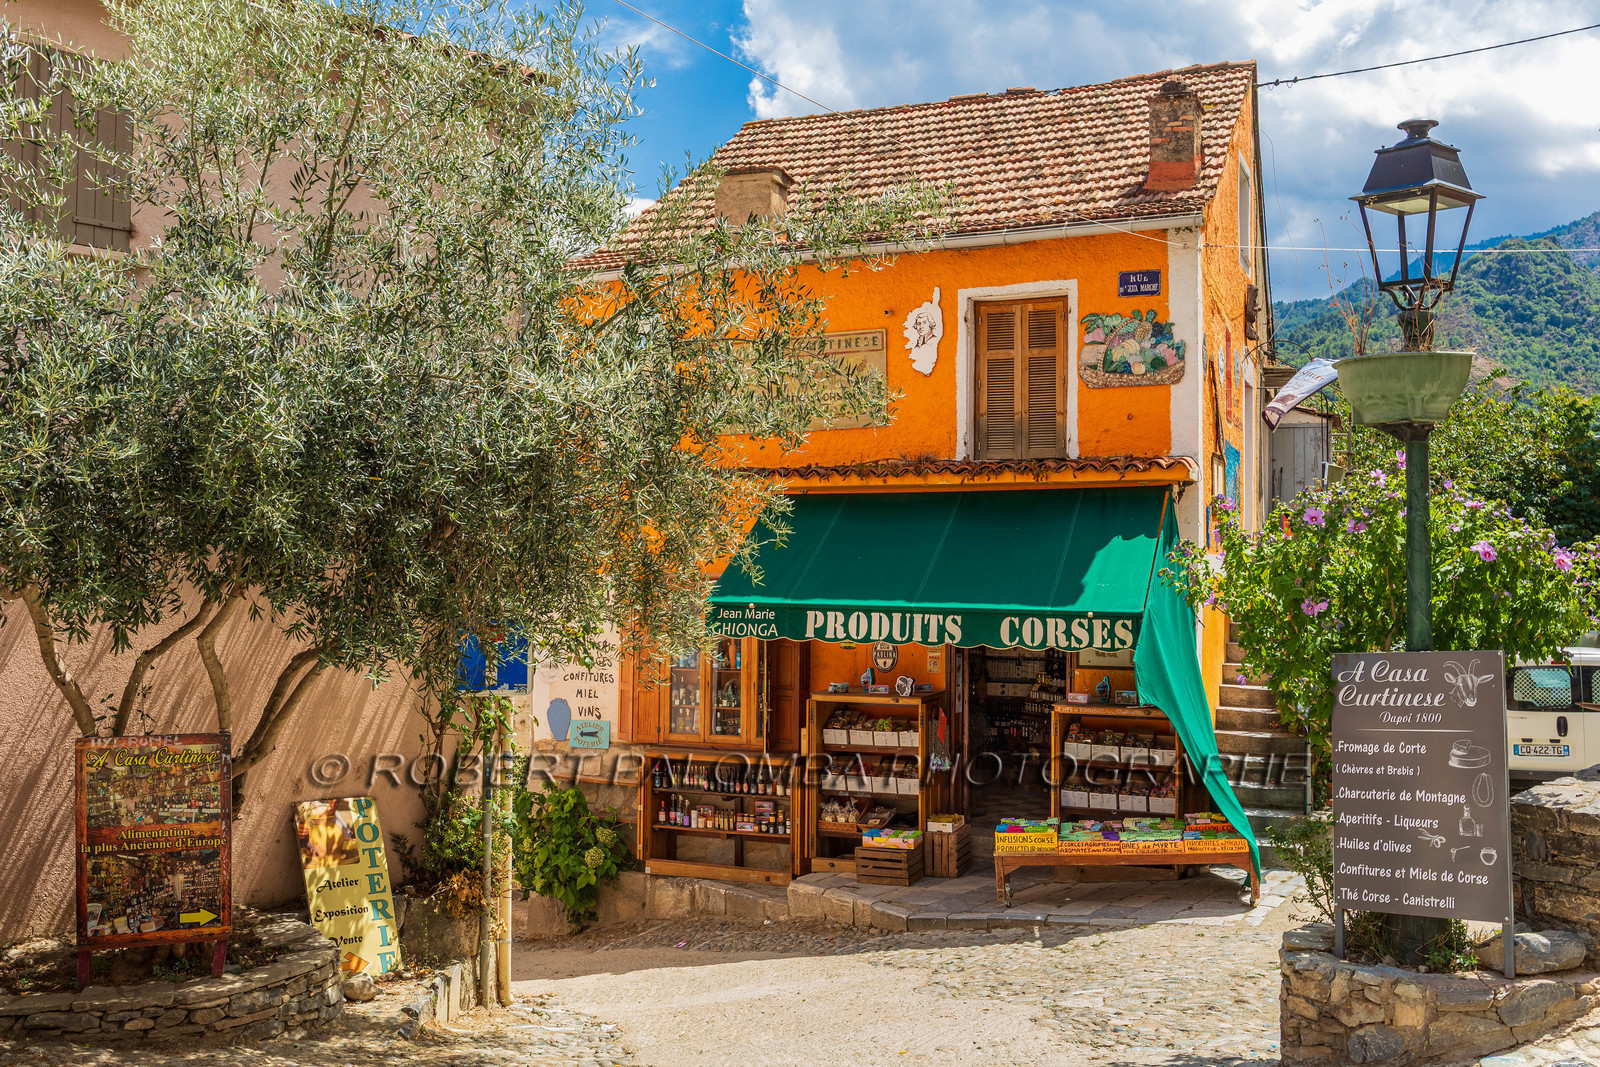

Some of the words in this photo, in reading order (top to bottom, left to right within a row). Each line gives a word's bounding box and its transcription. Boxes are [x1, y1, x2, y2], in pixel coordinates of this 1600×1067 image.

[718, 608, 742, 620] Jean
[744, 608, 776, 620] Marie
[712, 622, 778, 638] GHIONGA
[804, 610, 963, 644] PRODUITS
[1000, 616, 1134, 650] CORSES
[563, 671, 615, 684] CONFITURES
[1337, 660, 1365, 683] A
[1370, 660, 1430, 683] Casa
[576, 688, 599, 699] MIEL
[1338, 684, 1446, 707] Curtinese
[578, 705, 602, 720] VINS
[1379, 712, 1412, 726] Dapoi
[1415, 712, 1442, 724] 1800
[576, 722, 604, 733] ATELIER
[91, 736, 183, 748] HYDROMEL
[574, 736, 604, 748] POTERIE
[1383, 742, 1396, 753] de
[1399, 742, 1427, 754] Corte
[85, 749, 111, 767] A
[115, 748, 148, 766] Casa
[155, 746, 218, 765] Curtinese
[1342, 764, 1374, 775] Chèvres
[1376, 766, 1385, 775] et
[1387, 765, 1414, 776] Brebis
[1400, 790, 1412, 801] de
[1415, 790, 1467, 806] Montagne
[1394, 814, 1440, 830] Liqueurs
[118, 828, 191, 840] Alimentation
[996, 834, 1033, 844] INFUSIONS
[81, 843, 92, 854] la
[94, 842, 118, 855] plus
[120, 840, 172, 851] Ancienne
[175, 836, 227, 850] d'Europe
[1373, 839, 1412, 853] d'olives
[1395, 868, 1406, 878] et
[1409, 867, 1438, 882] Miels
[1440, 870, 1454, 882] de
[1457, 871, 1490, 885] Corse
[316, 878, 360, 893] Atelier
[354, 799, 399, 975] POTERIE
[1362, 889, 1392, 903] Corse
[1402, 893, 1456, 910] Canistrelli
[314, 905, 369, 922] Exposition
[328, 936, 364, 949] Vente
